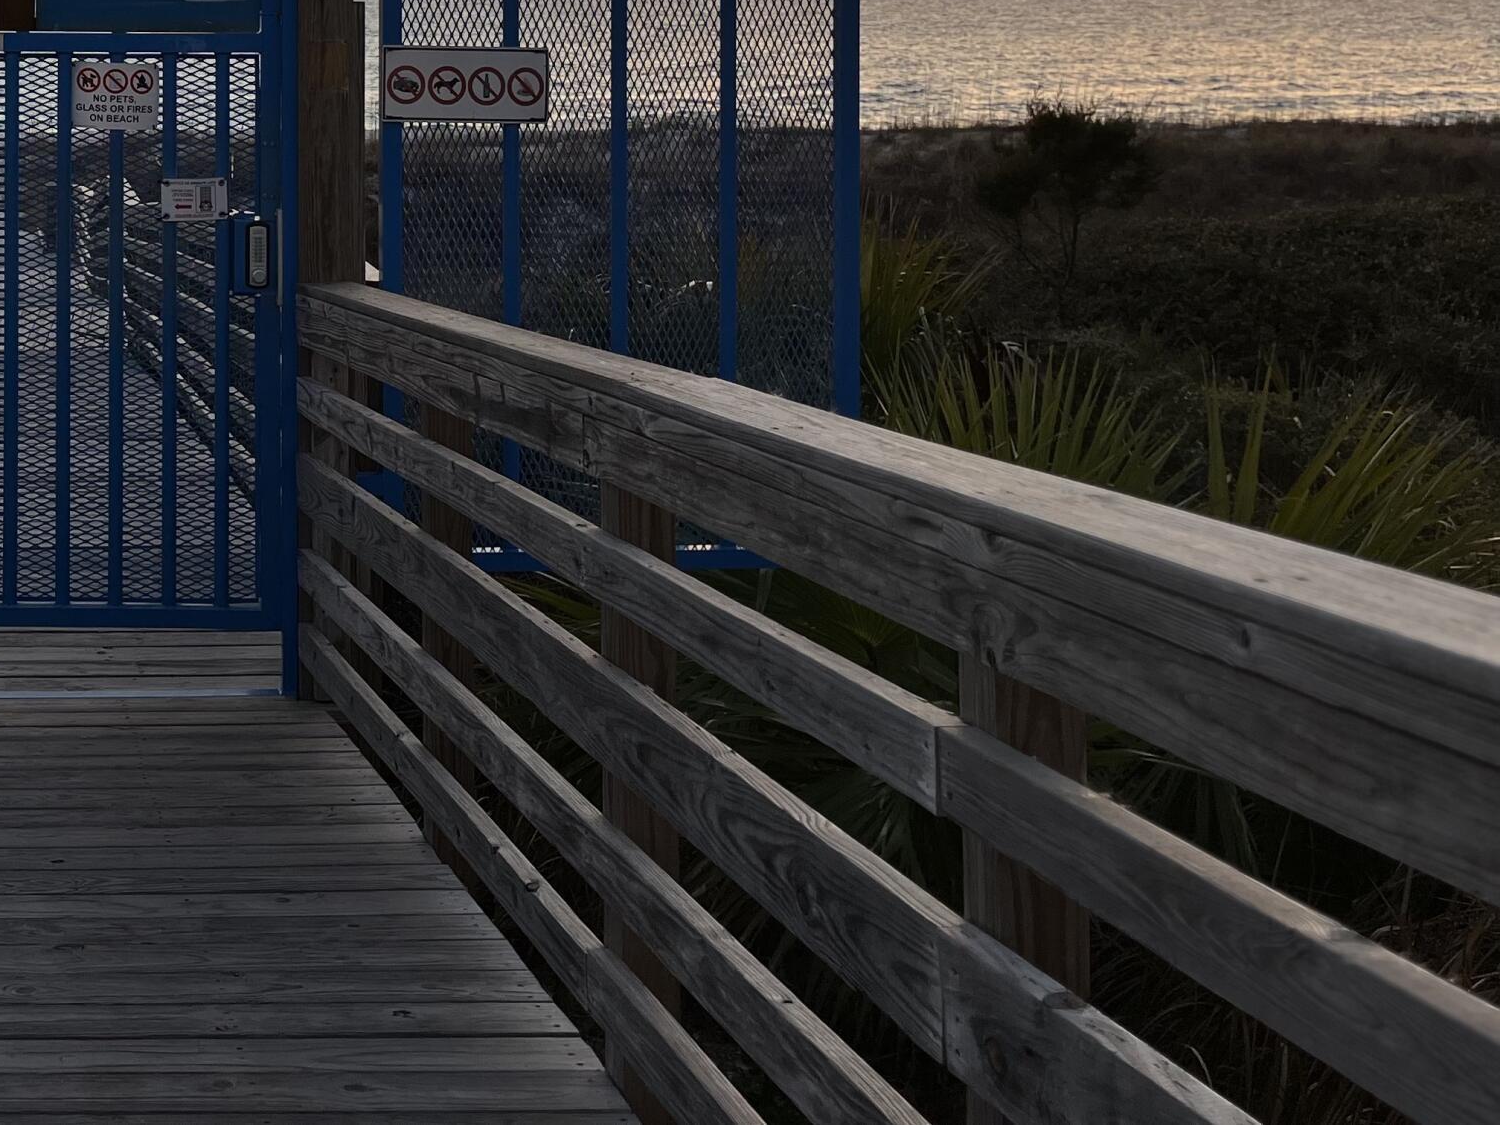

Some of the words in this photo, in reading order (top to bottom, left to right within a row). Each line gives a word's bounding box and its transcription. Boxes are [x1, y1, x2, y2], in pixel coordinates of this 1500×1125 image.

[93, 94, 107, 103] NO
[109, 95, 137, 104] PETS,
[75, 103, 107, 112] GLASS
[109, 104, 124, 113] OR
[126, 105, 153, 114] FIRES
[89, 113, 104, 122] ON
[106, 114, 139, 123] BEACH
